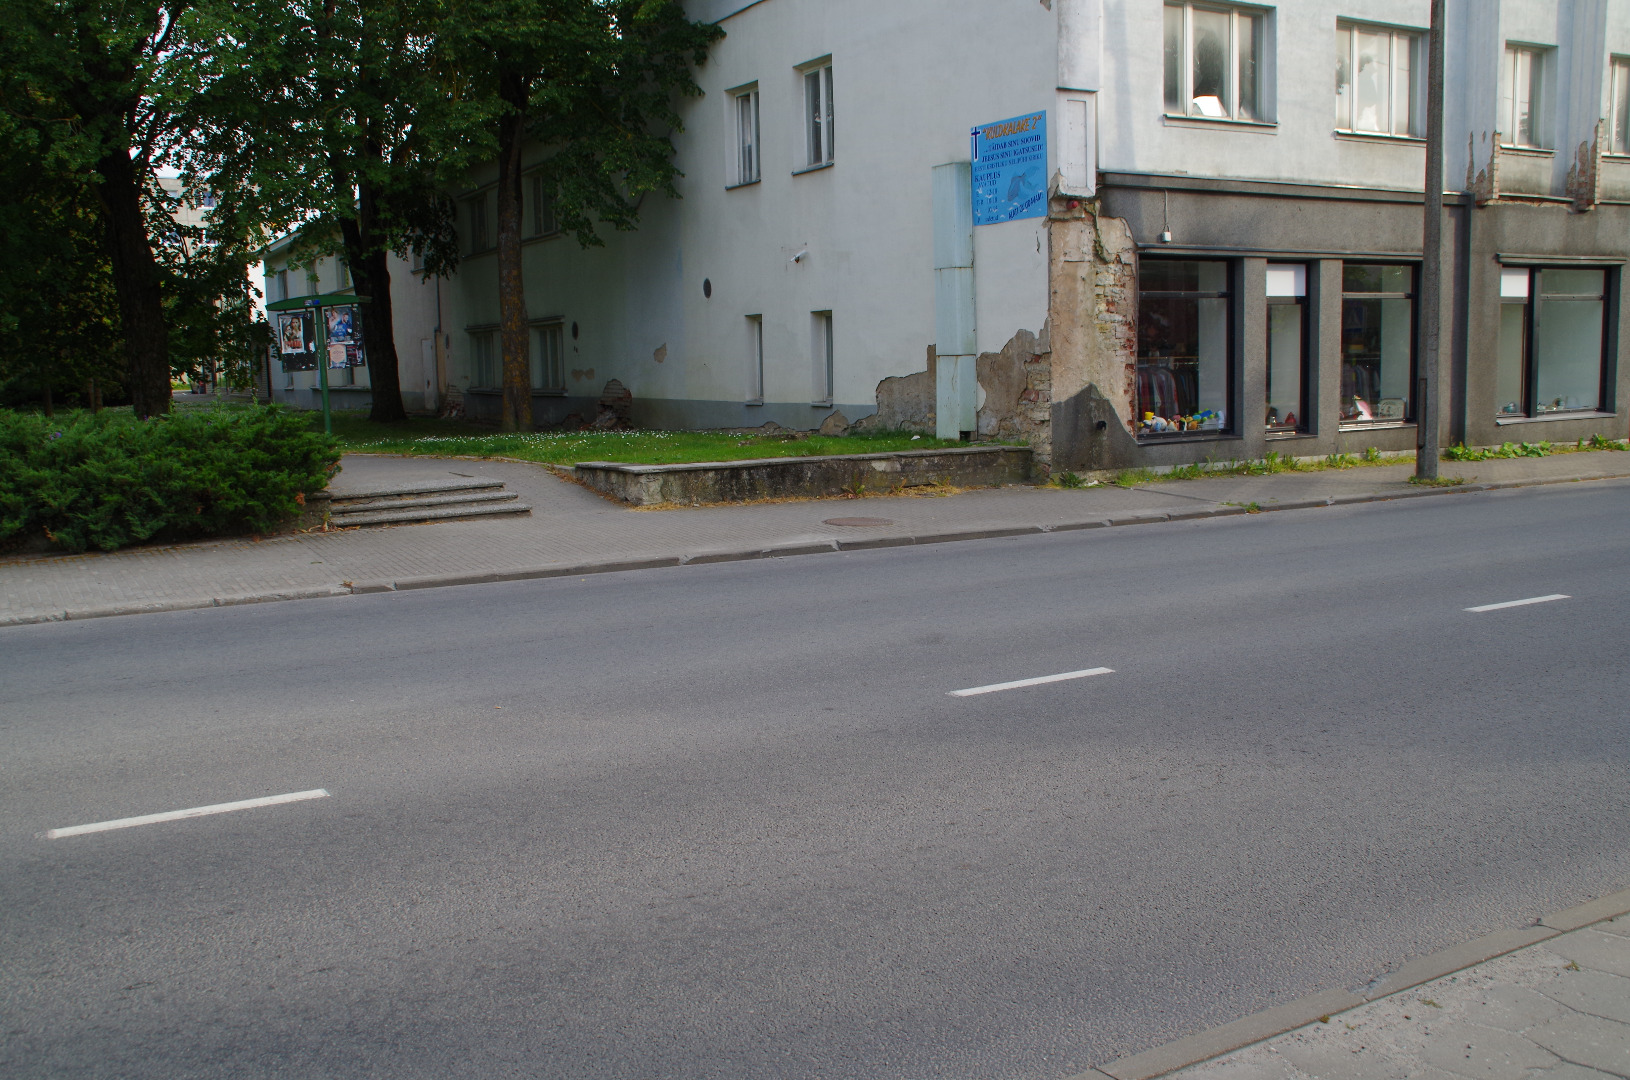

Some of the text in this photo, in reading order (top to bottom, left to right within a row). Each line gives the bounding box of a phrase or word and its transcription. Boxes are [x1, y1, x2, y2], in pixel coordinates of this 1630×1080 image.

[1008, 140, 1019, 148] SINU
[1020, 134, 1040, 144] SOOVID
[975, 171, 1000, 182] KAUPLUS
